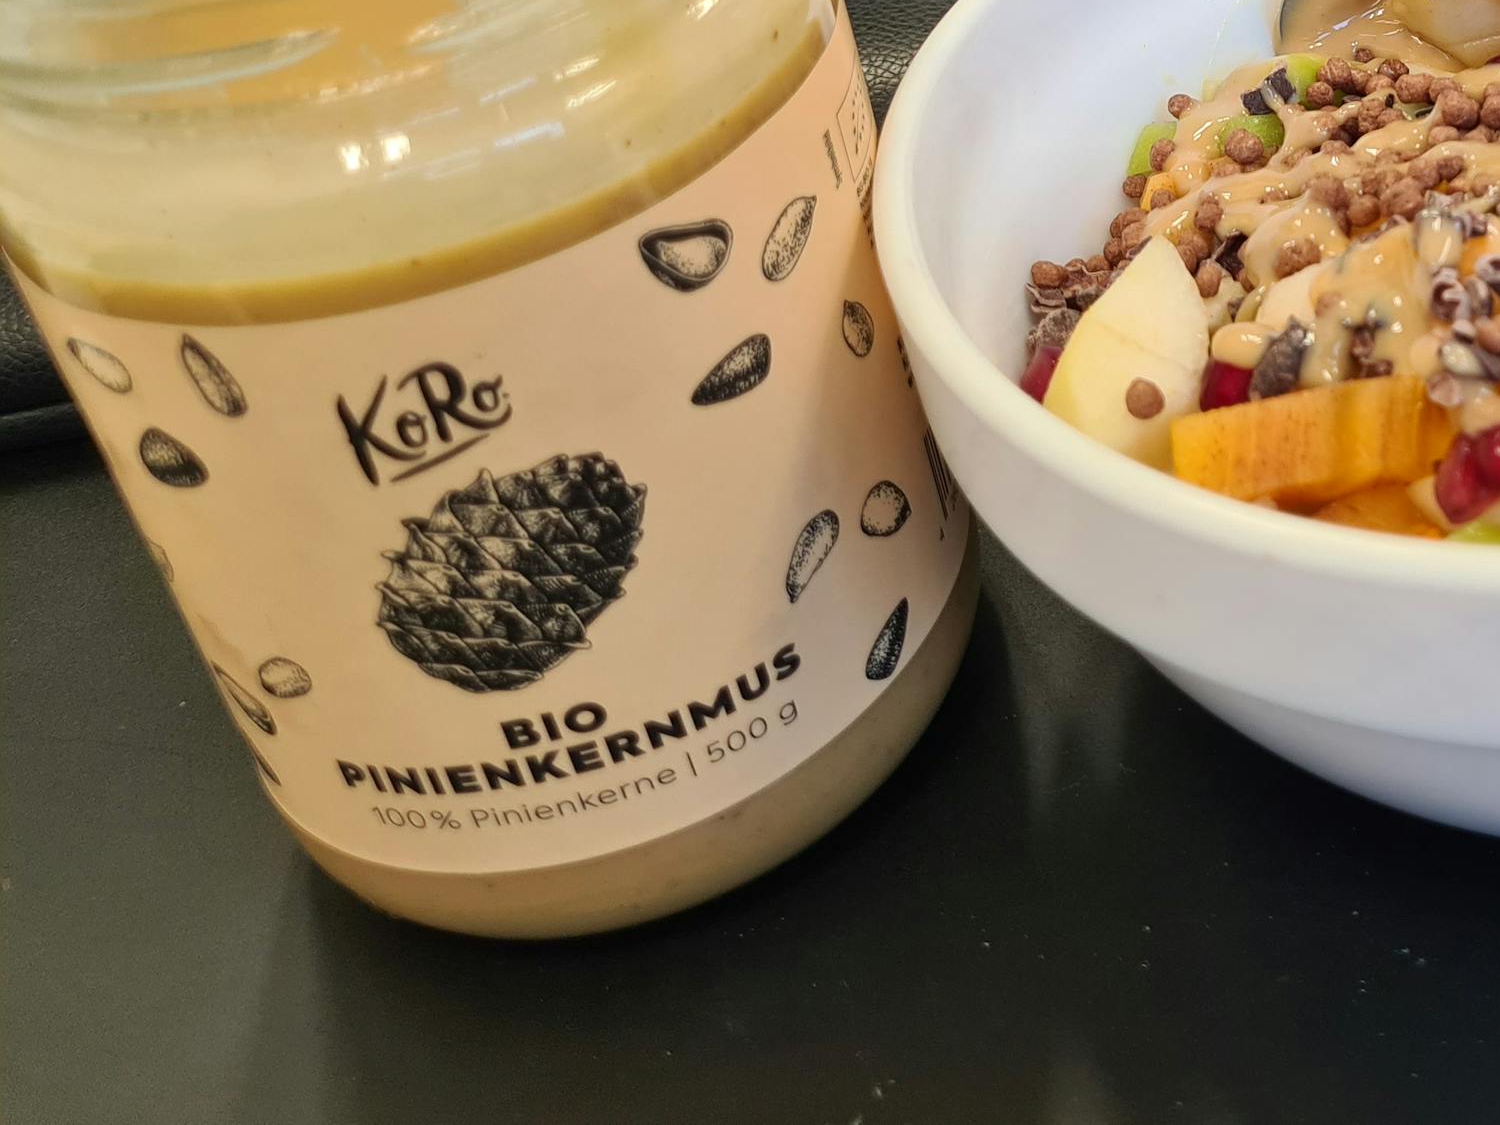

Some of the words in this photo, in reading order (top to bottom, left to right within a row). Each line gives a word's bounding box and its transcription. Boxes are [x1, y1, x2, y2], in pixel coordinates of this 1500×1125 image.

[336, 361, 512, 485] KoRo
[335, 642, 802, 796] PINIENKERNMUS
[372, 805, 462, 831] 100%
[470, 764, 678, 829] Pinienkerne
[706, 716, 769, 764] 500
[779, 699, 800, 725] g
[500, 701, 608, 750] BIO
